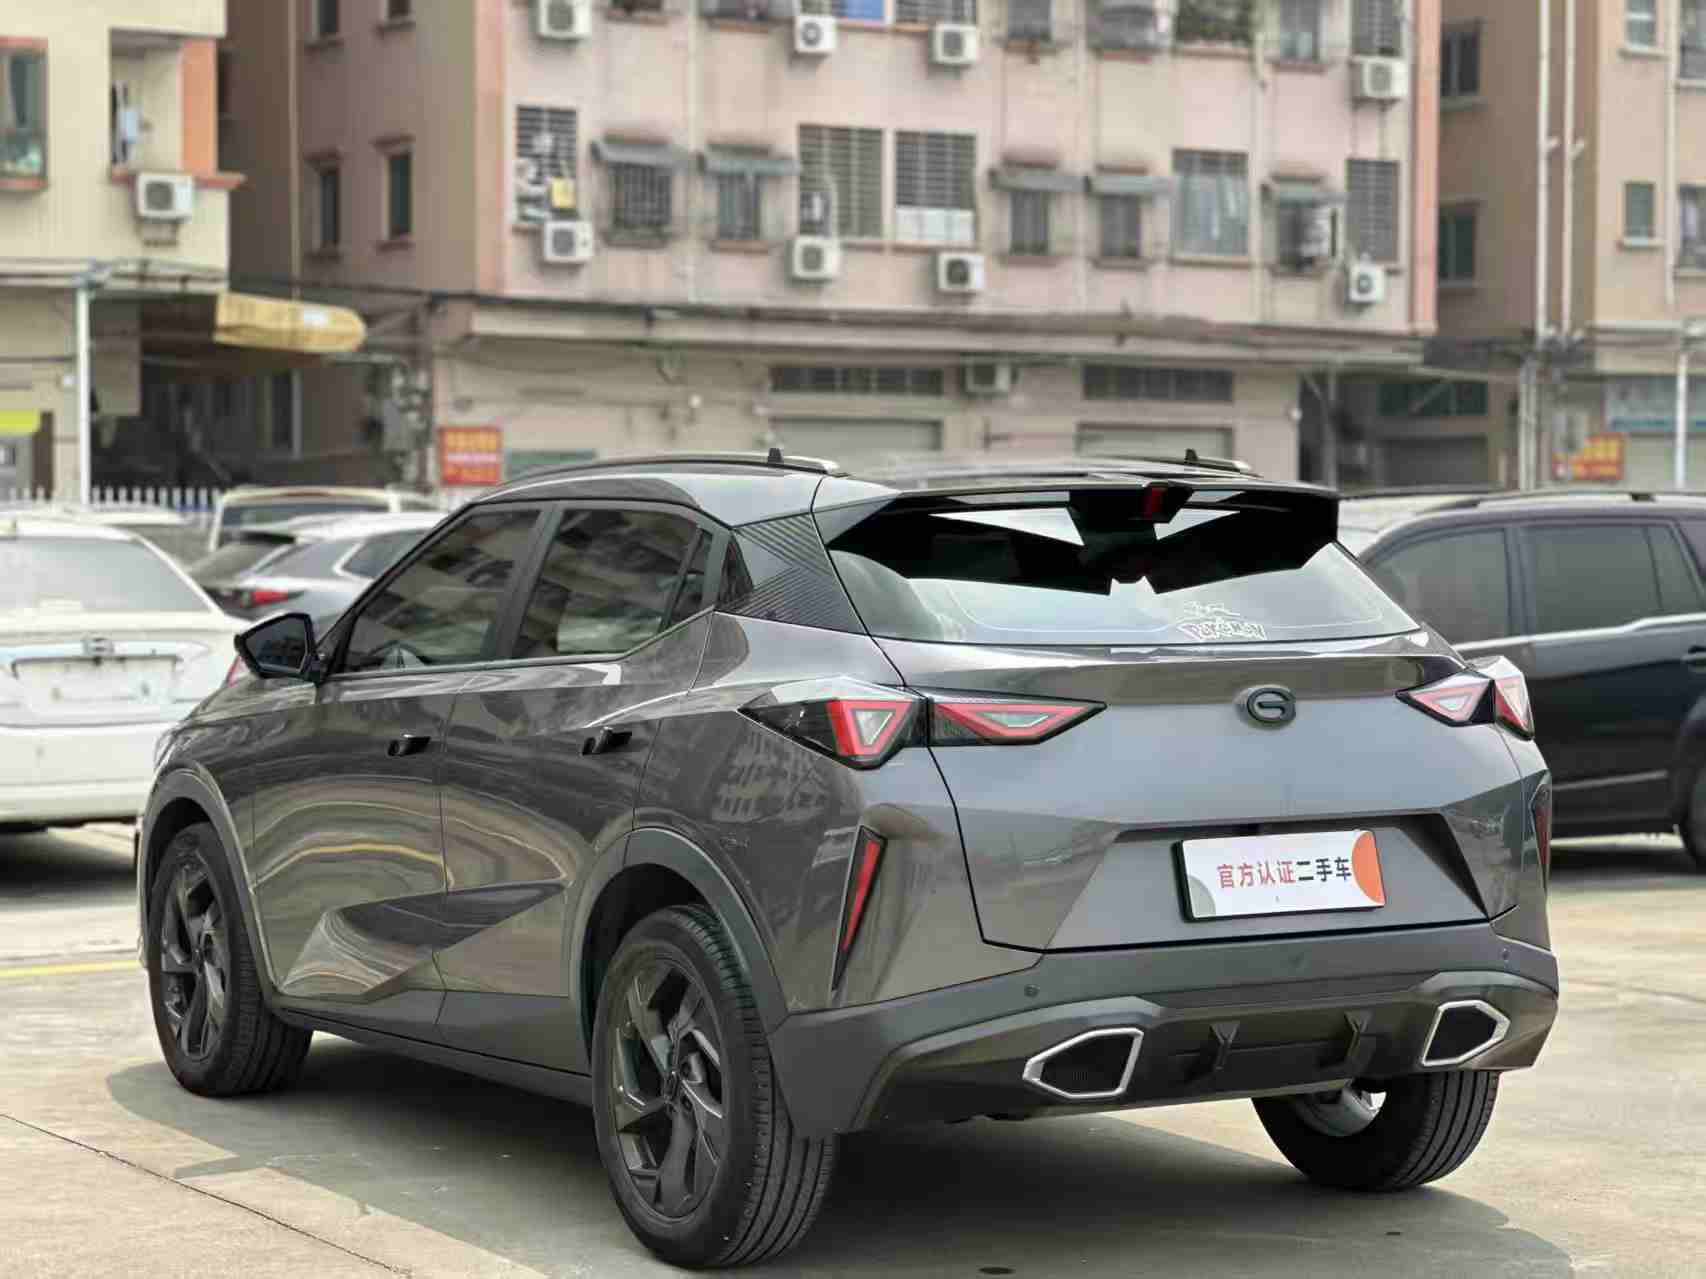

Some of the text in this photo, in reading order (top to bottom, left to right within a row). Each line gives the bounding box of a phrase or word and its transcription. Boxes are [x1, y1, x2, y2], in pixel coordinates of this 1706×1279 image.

[1217, 856, 1352, 889] 官方认证二手车
